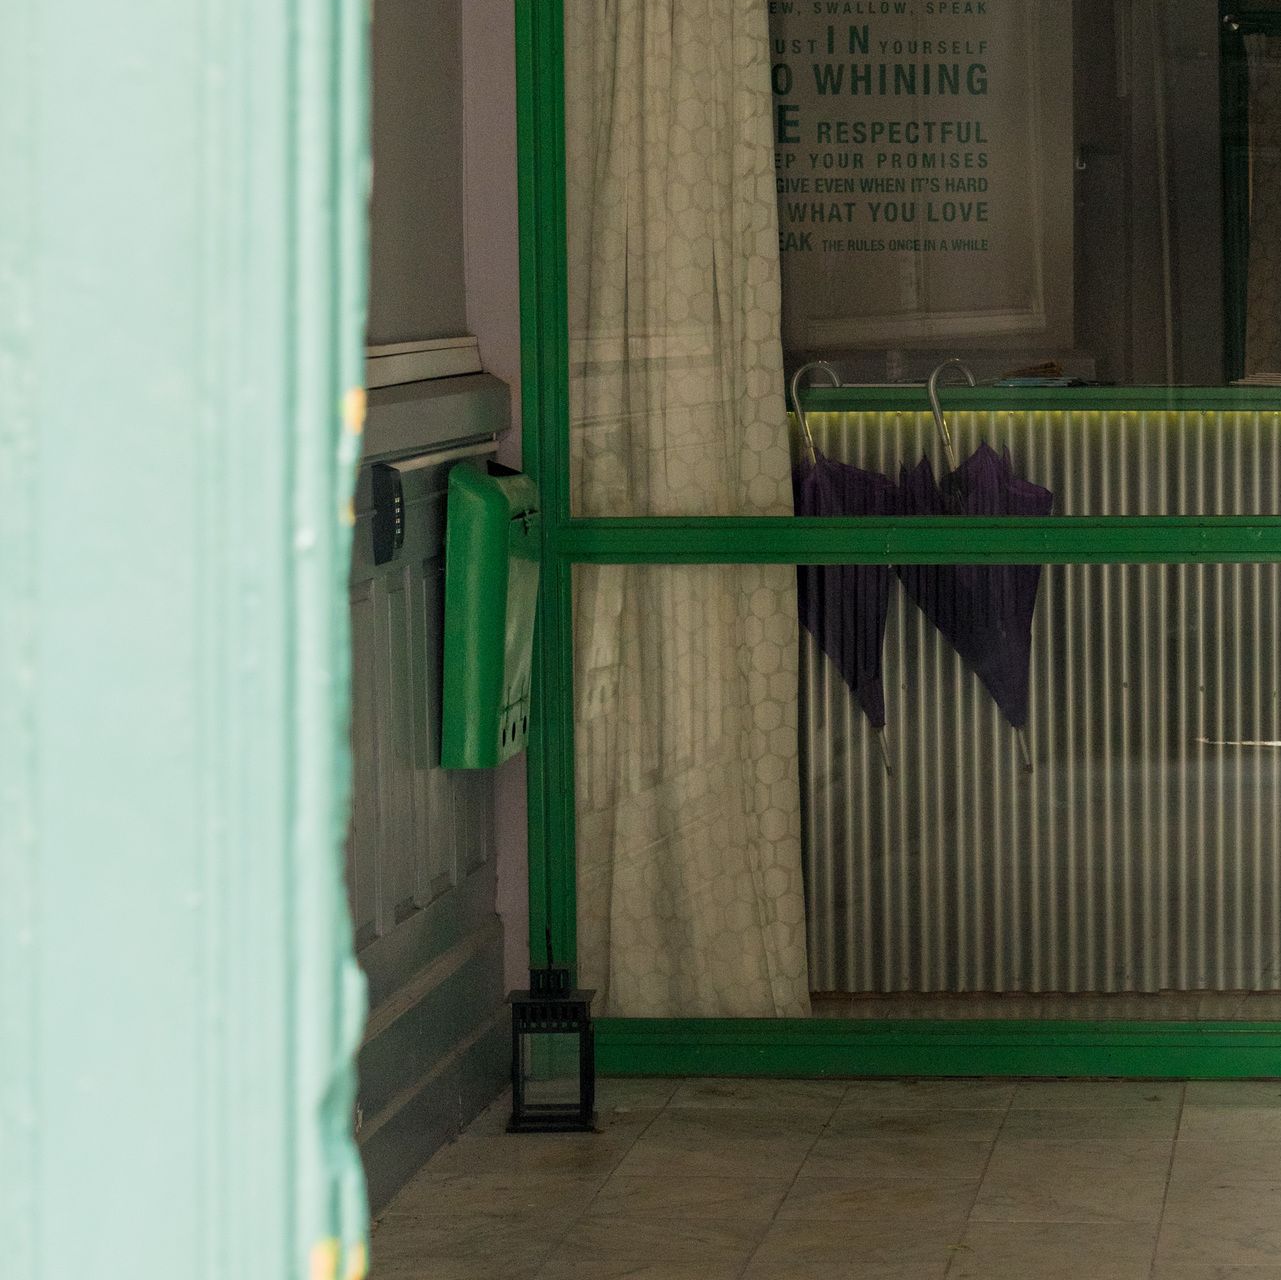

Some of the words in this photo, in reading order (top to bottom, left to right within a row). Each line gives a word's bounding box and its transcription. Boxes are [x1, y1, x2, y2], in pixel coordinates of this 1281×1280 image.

[769, 1, 802, 16] EW,
[813, 1, 915, 17] SWALLOW,
[926, 1, 987, 15] SPEAK
[774, 39, 818, 54] UST
[826, 24, 870, 55] IN
[879, 39, 988, 54] YOURSELF
[771, 63, 793, 96] O
[812, 62, 989, 96] WHINING
[777, 104, 801, 144] E
[816, 121, 988, 144] RESPECTFUL
[809, 152, 865, 169] YOUR
[877, 152, 989, 169] PROMISES
[776, 177, 810, 194] GIVE
[815, 177, 855, 193] EVEN
[859, 177, 906, 193] WHEN
[911, 177, 941, 193] IT'S
[945, 177, 988, 193] HARD
[787, 202, 857, 223] WHAT
[867, 202, 917, 223] YOU
[927, 201, 989, 223] LOVE
[822, 239, 845, 252] THE
[847, 239, 885, 252] RULES
[889, 239, 920, 252] ONCE
[924, 239, 936, 251] IN
[939, 239, 948, 251] A
[952, 238, 989, 251] WHILE
